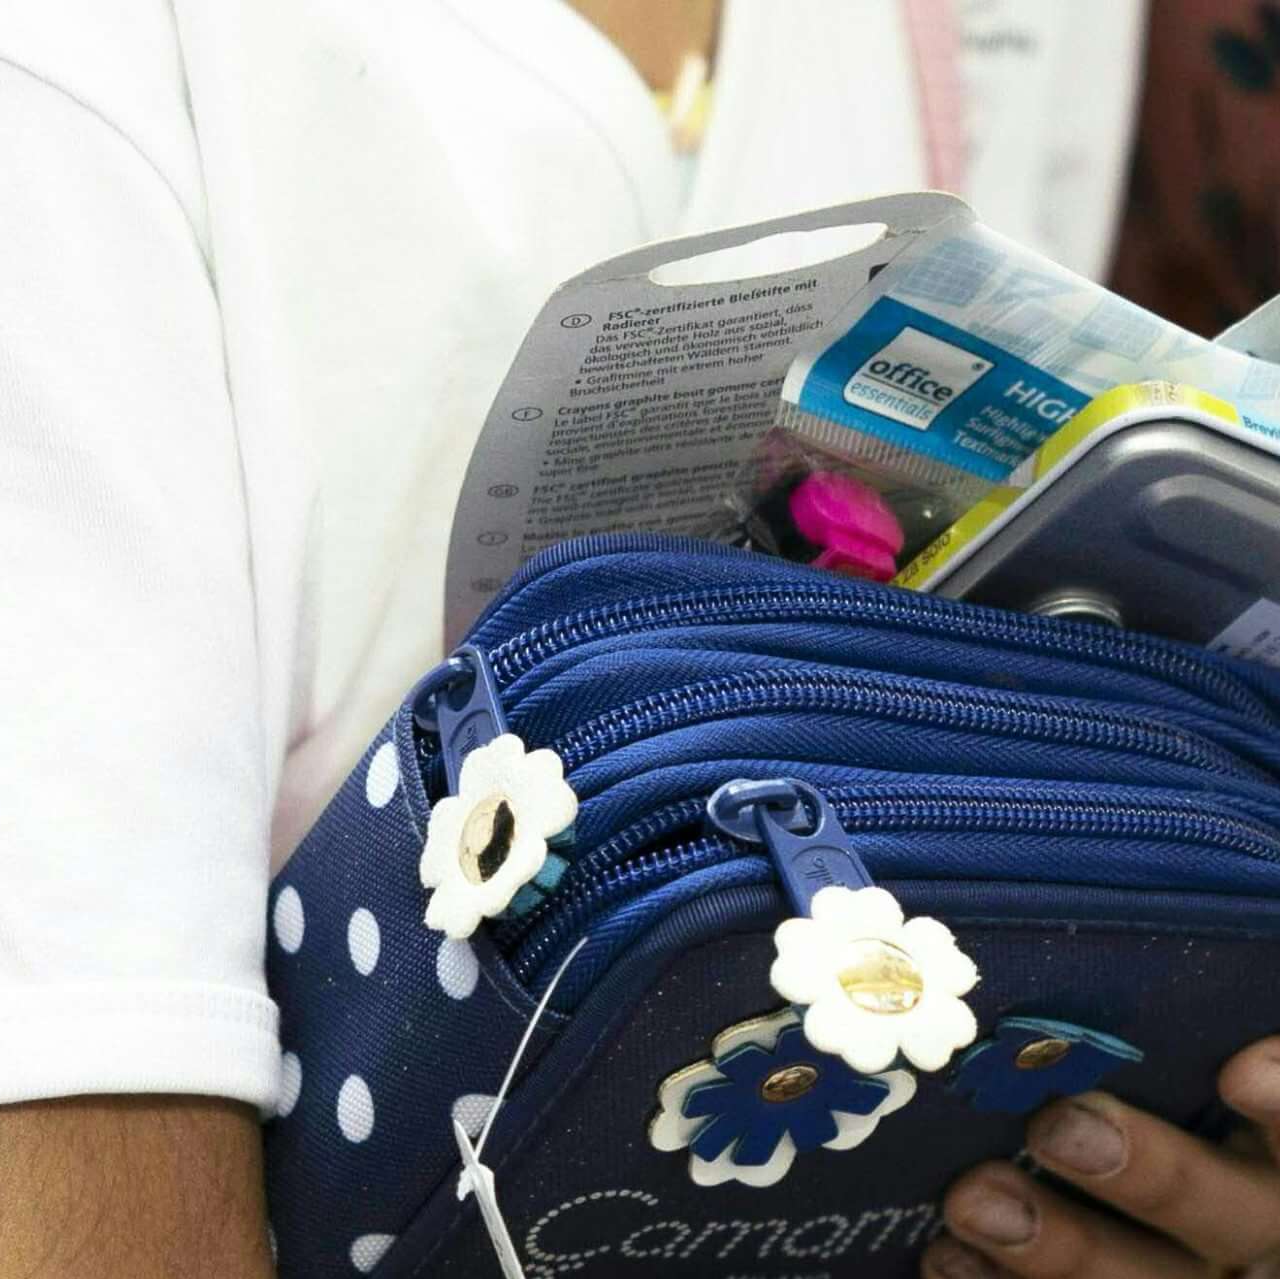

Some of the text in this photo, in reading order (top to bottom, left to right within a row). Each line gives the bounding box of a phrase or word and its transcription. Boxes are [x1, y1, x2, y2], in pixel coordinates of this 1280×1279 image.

[794, 279, 818, 293] mit
[602, 317, 660, 332] Radierer
[595, 335, 619, 344] Das
[693, 329, 720, 340] Holz
[868, 359, 954, 401] office
[850, 382, 933, 421] essentials
